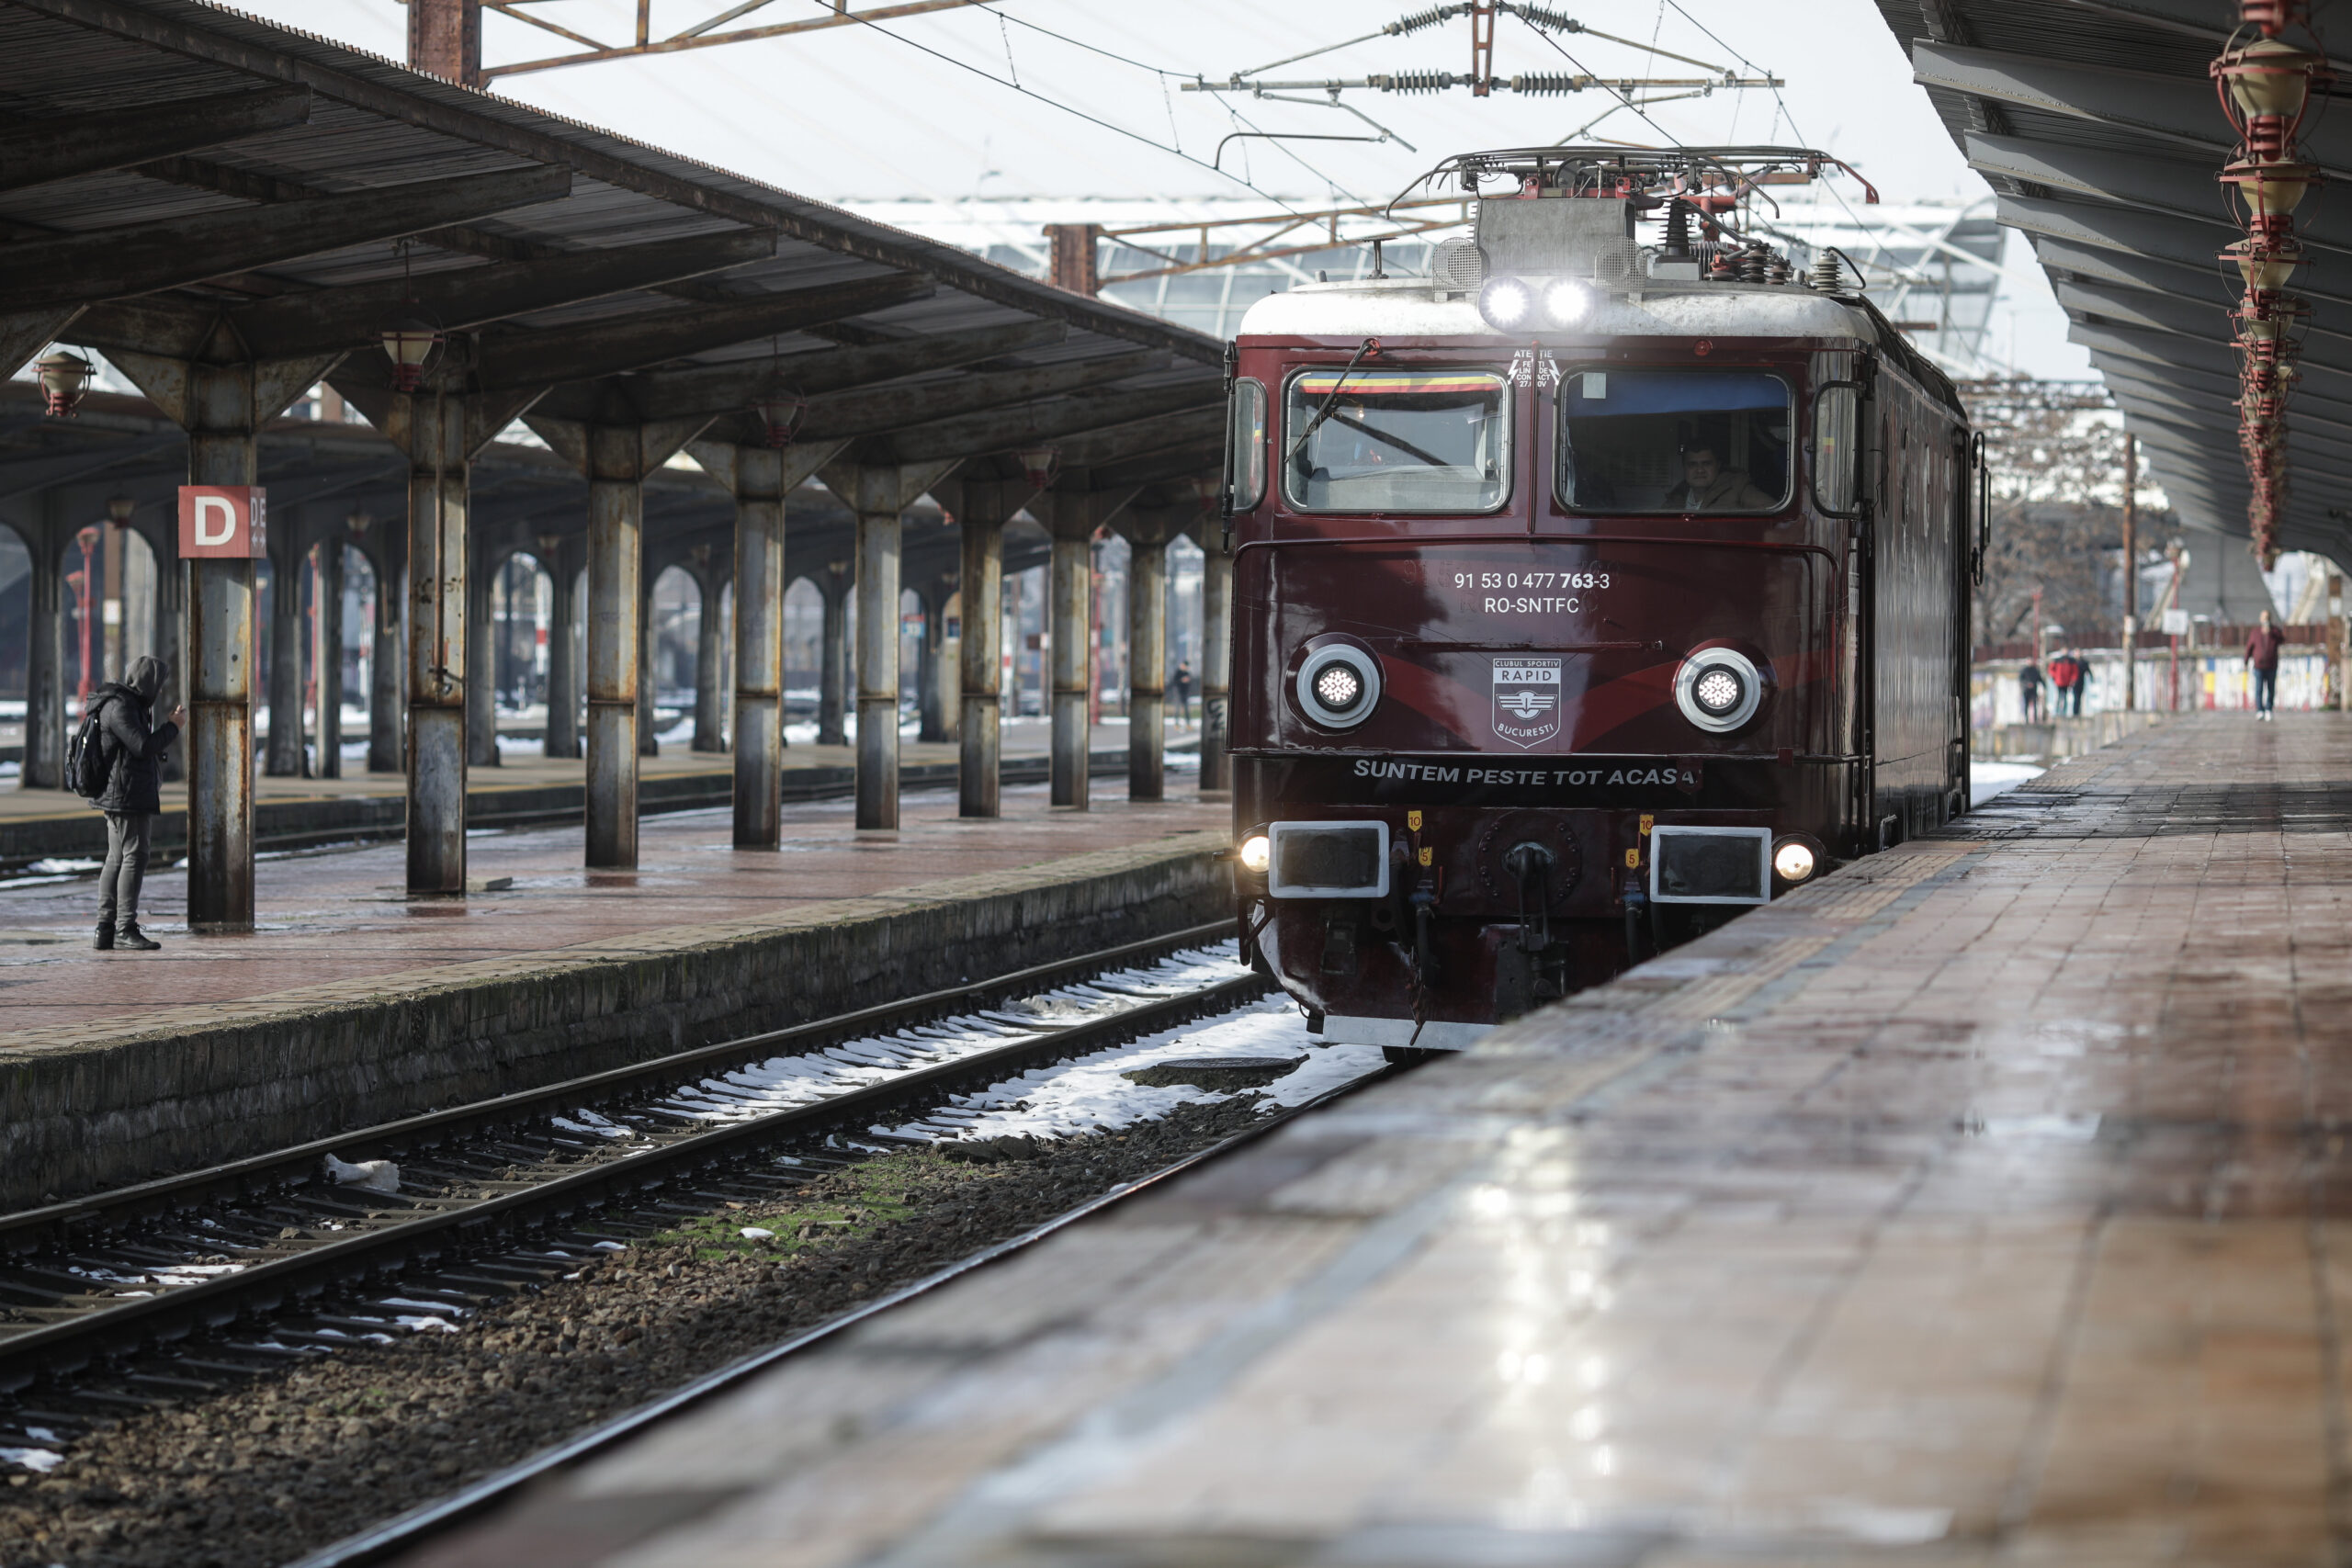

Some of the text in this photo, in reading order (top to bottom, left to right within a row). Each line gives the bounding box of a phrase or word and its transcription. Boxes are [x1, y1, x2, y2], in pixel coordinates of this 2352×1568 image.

[195, 496, 236, 546] D
[1454, 572, 1473, 589] 91
[1481, 572, 1501, 589] 53
[1507, 572, 1518, 589] 0
[1521, 572, 1555, 589] 477
[1559, 572, 1610, 589] 763-3
[1485, 597, 1579, 614] RO-SNTFC
[1501, 671, 1552, 682] RAPID
[1353, 759, 1460, 783] SUNTEM
[1466, 768, 1547, 785] PESTE
[1553, 770, 1603, 785] TOT
[1409, 816, 1421, 827] 10
[1641, 819, 1653, 830] 10
[1421, 852, 1429, 862] 5
[1629, 853, 1635, 864] 5
